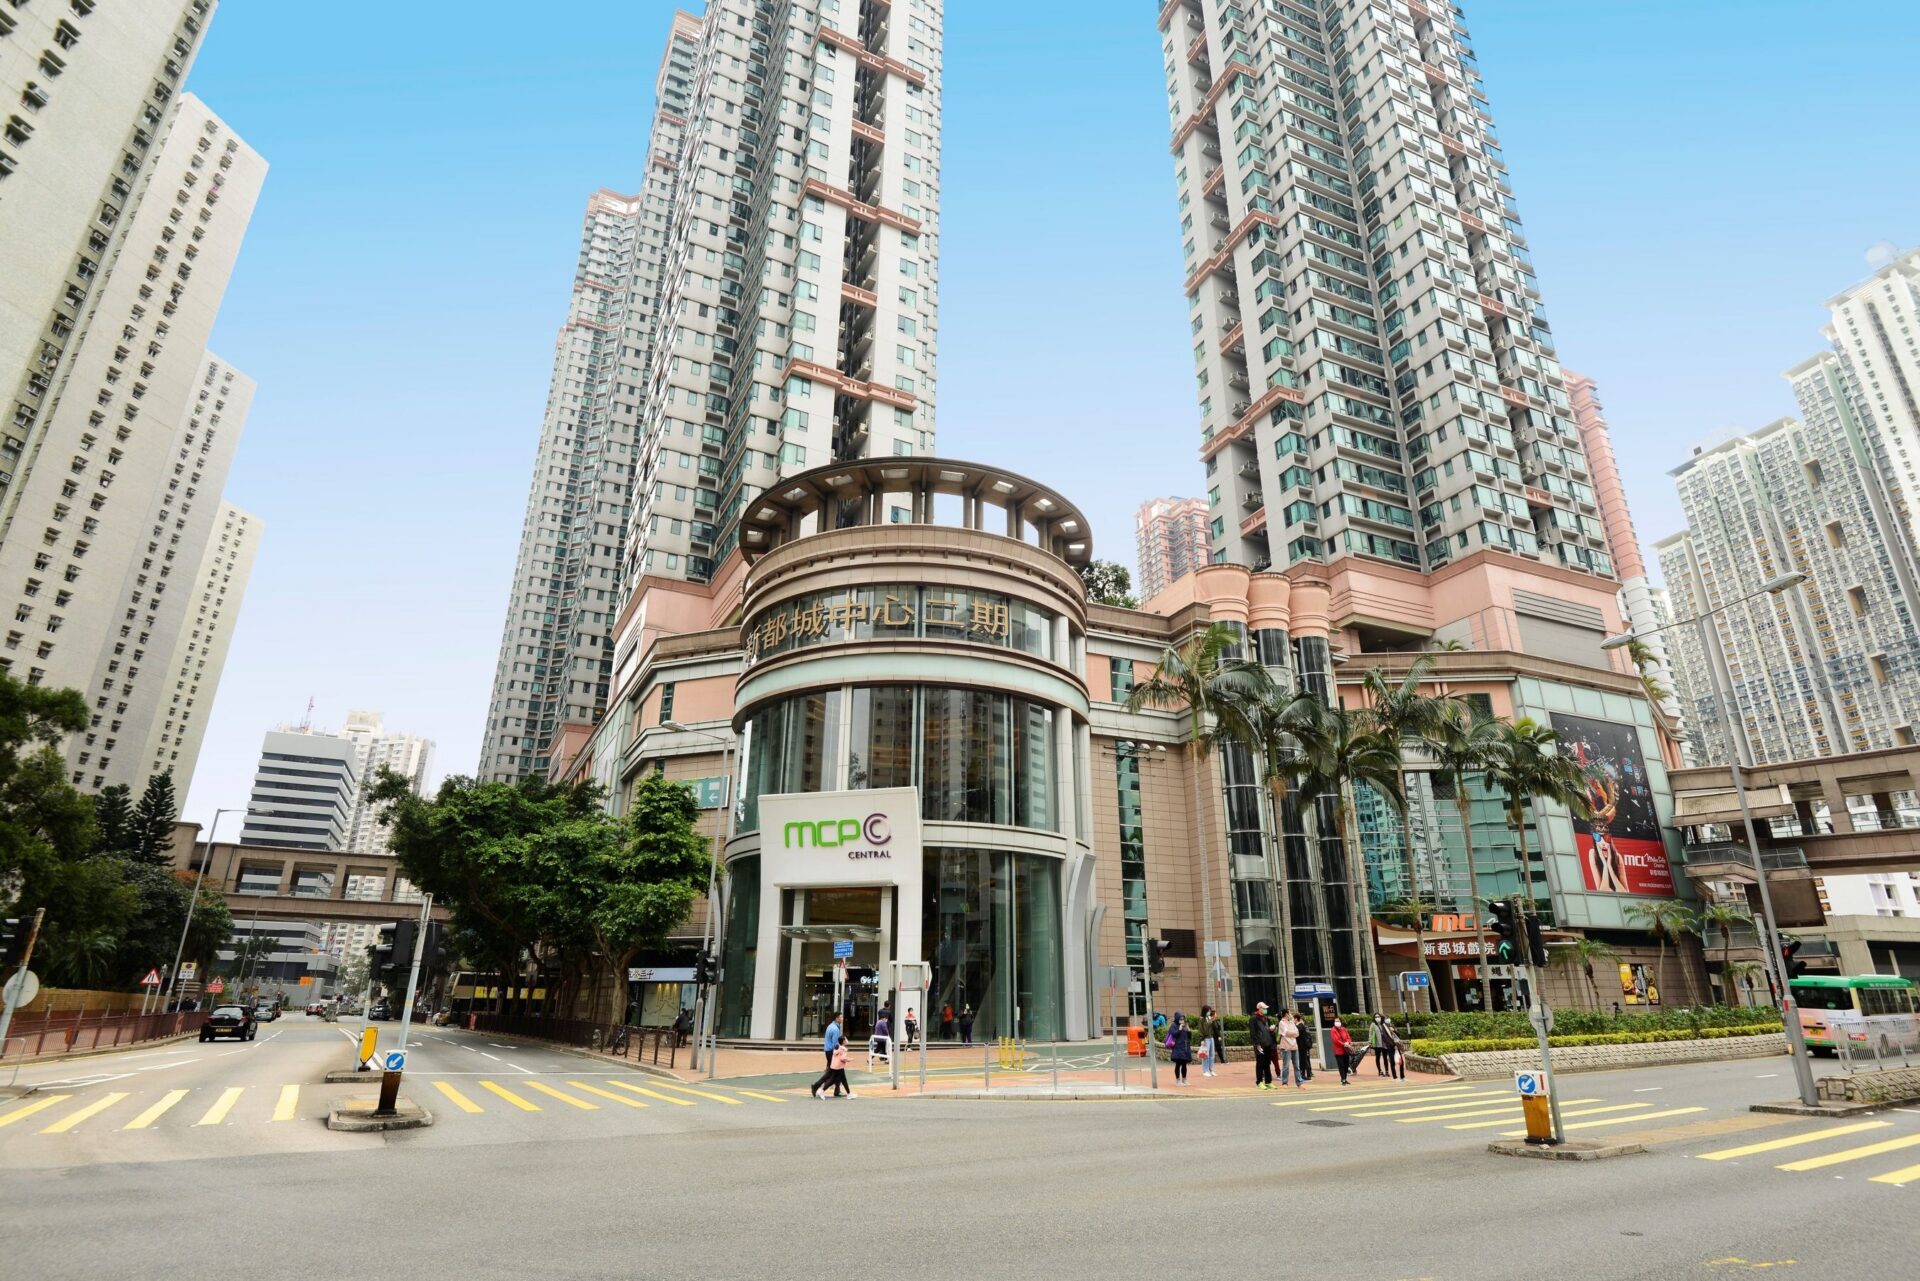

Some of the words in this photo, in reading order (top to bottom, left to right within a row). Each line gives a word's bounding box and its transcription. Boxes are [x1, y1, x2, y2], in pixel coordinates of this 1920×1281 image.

[746, 594, 1009, 661] 新都城中心二期
[848, 850, 892, 860] CENTRAL
